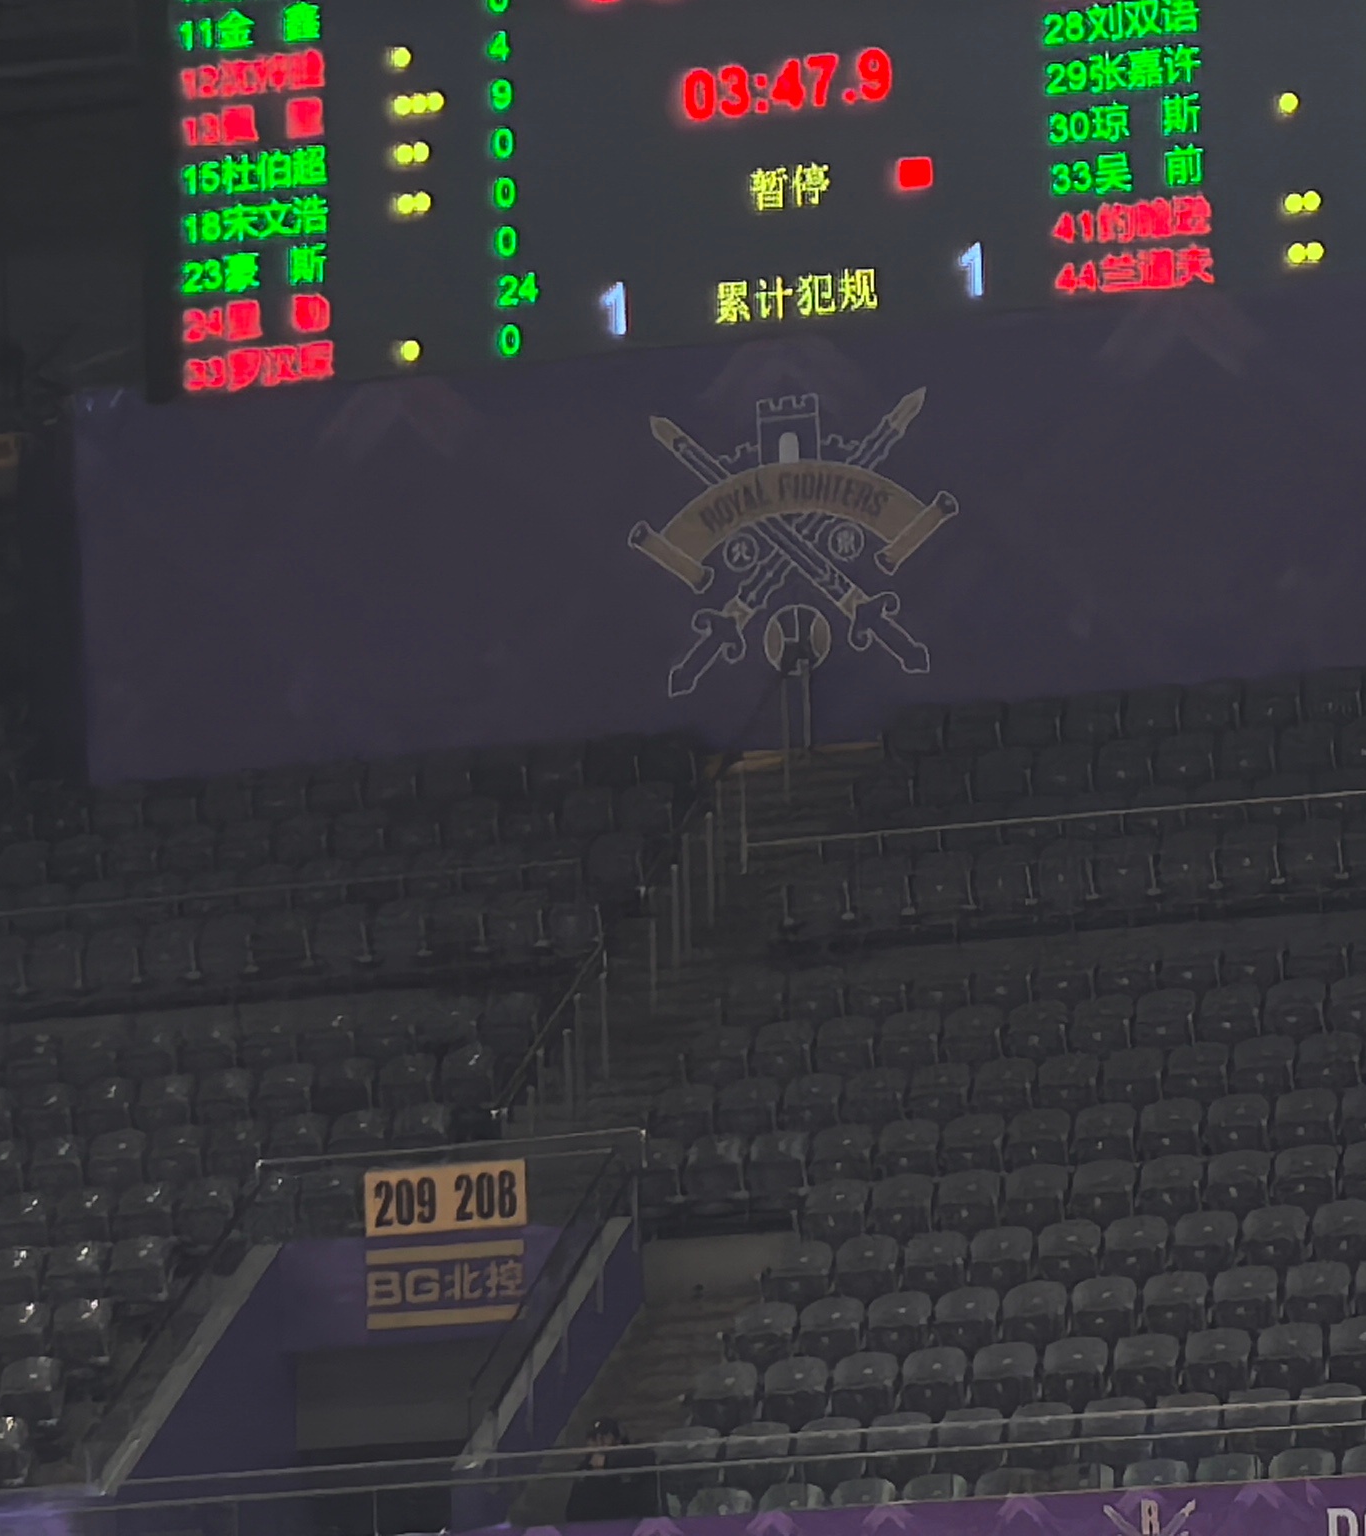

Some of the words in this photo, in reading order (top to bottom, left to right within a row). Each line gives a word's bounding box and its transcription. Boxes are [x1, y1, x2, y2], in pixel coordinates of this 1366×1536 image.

[487, 31, 512, 62] 4
[490, 79, 515, 112] 9
[681, 48, 893, 123] 03:47.9
[491, 128, 515, 161] 0
[493, 177, 517, 211] 0
[749, 162, 832, 213] 暂停
[494, 226, 519, 260] 0
[498, 273, 539, 308] 24
[598, 280, 628, 337] 1
[716, 268, 880, 325] 累计犯规
[957, 241, 985, 298] 1
[498, 325, 522, 358] 0
[699, 475, 773, 533] ROYAL
[779, 470, 892, 519] FIGHTERS
[374, 1176, 437, 1228] 209
[455, 1169, 517, 1222] 208
